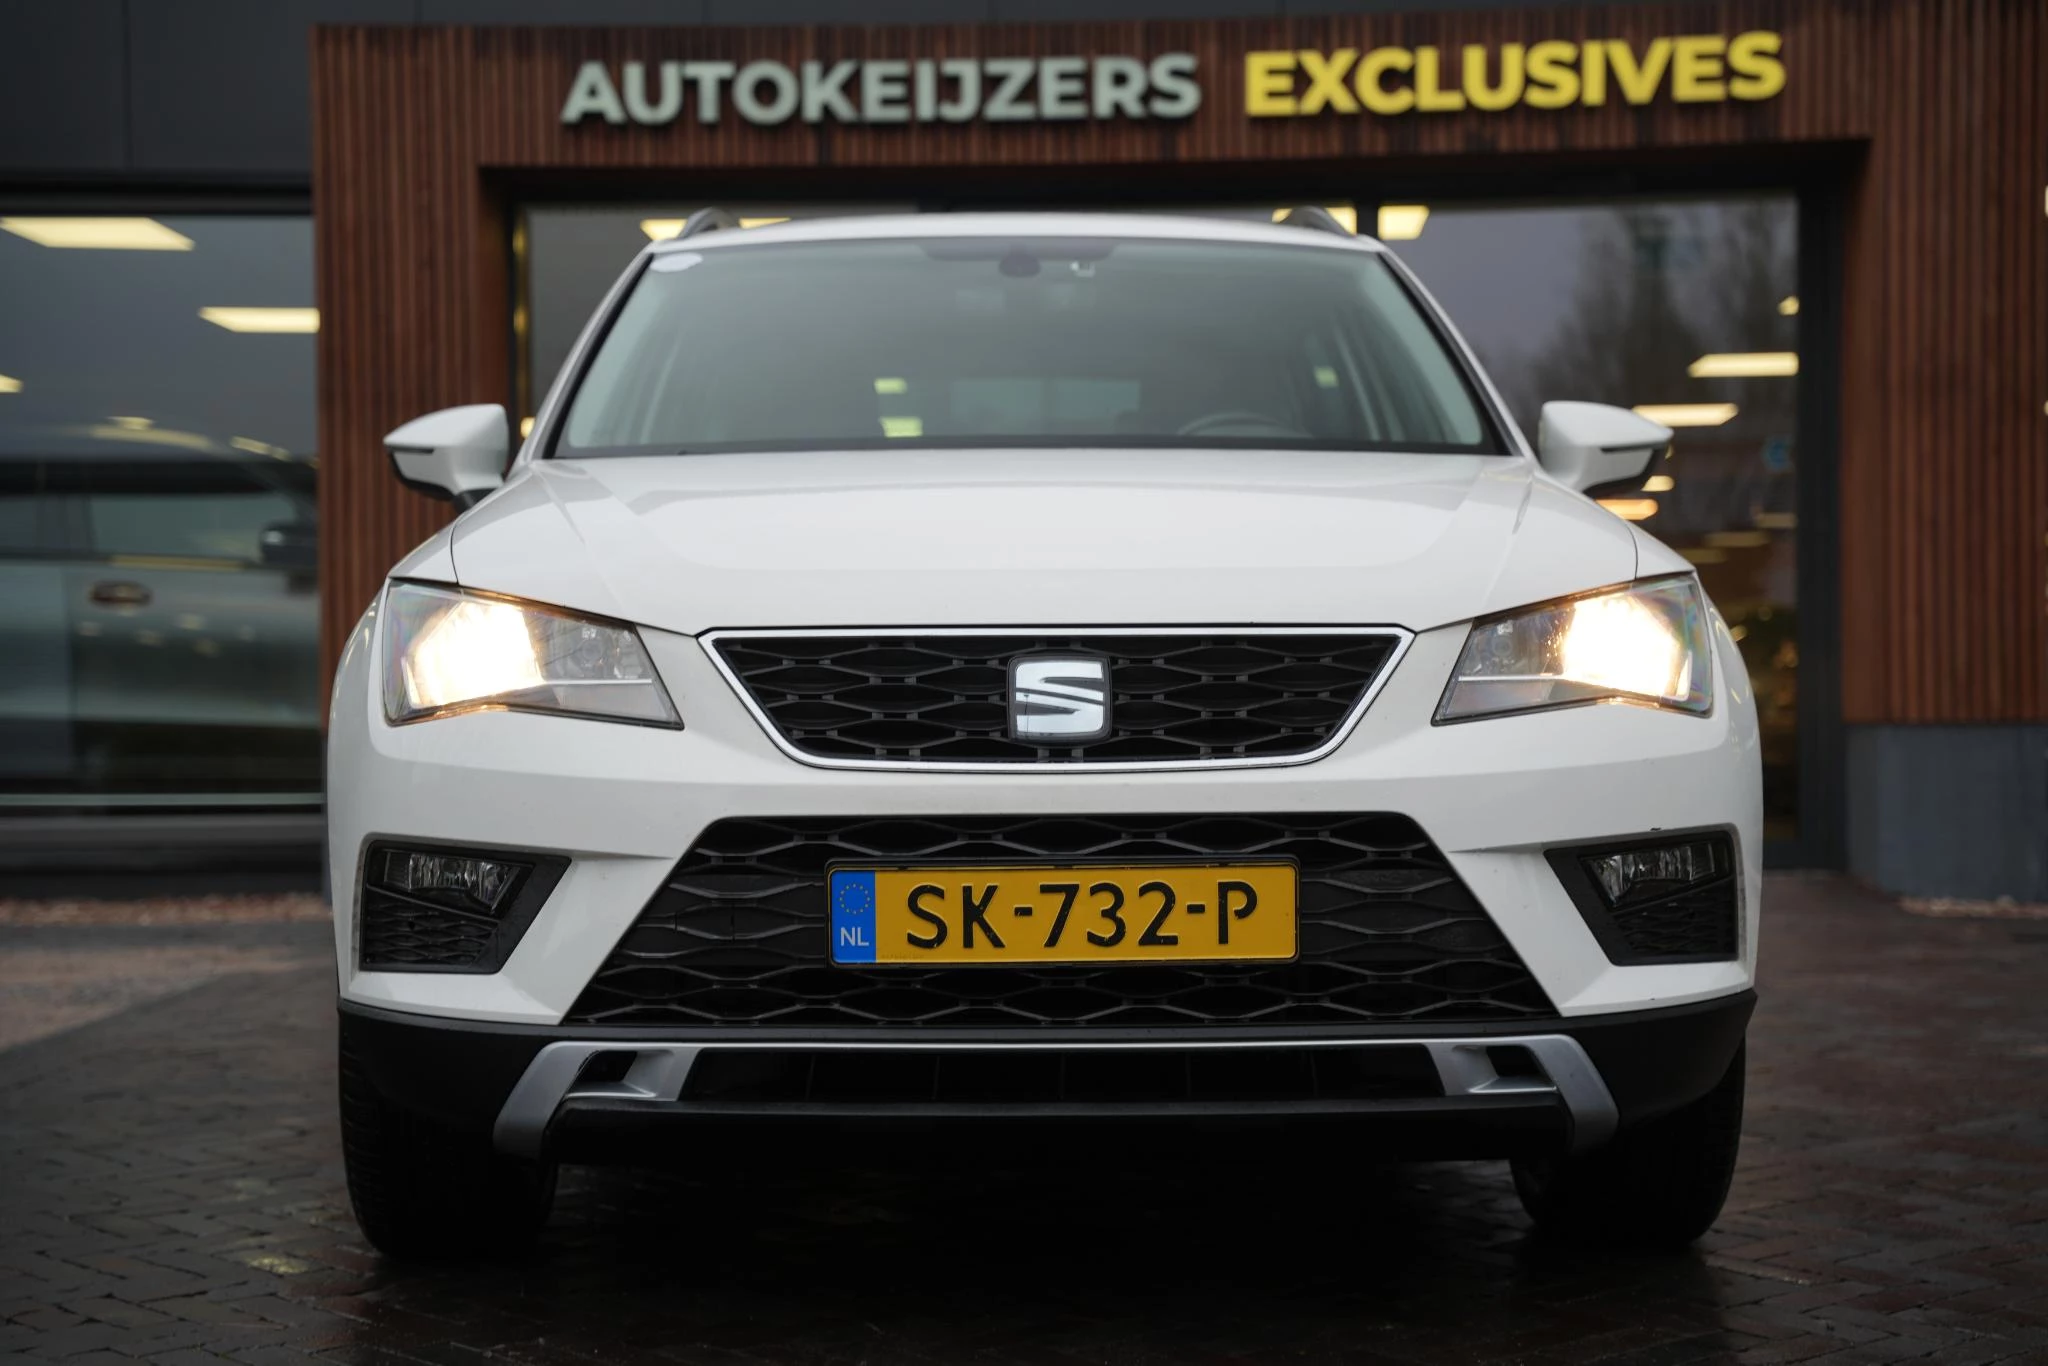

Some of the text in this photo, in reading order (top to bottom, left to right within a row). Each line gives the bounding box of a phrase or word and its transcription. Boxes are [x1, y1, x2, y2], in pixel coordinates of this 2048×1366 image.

[560, 31, 1787, 124] AUTOKEIJZERS EXCLUSIVES
[840, 927, 870, 946] NL
[906, 880, 1259, 949] SK-732-P
